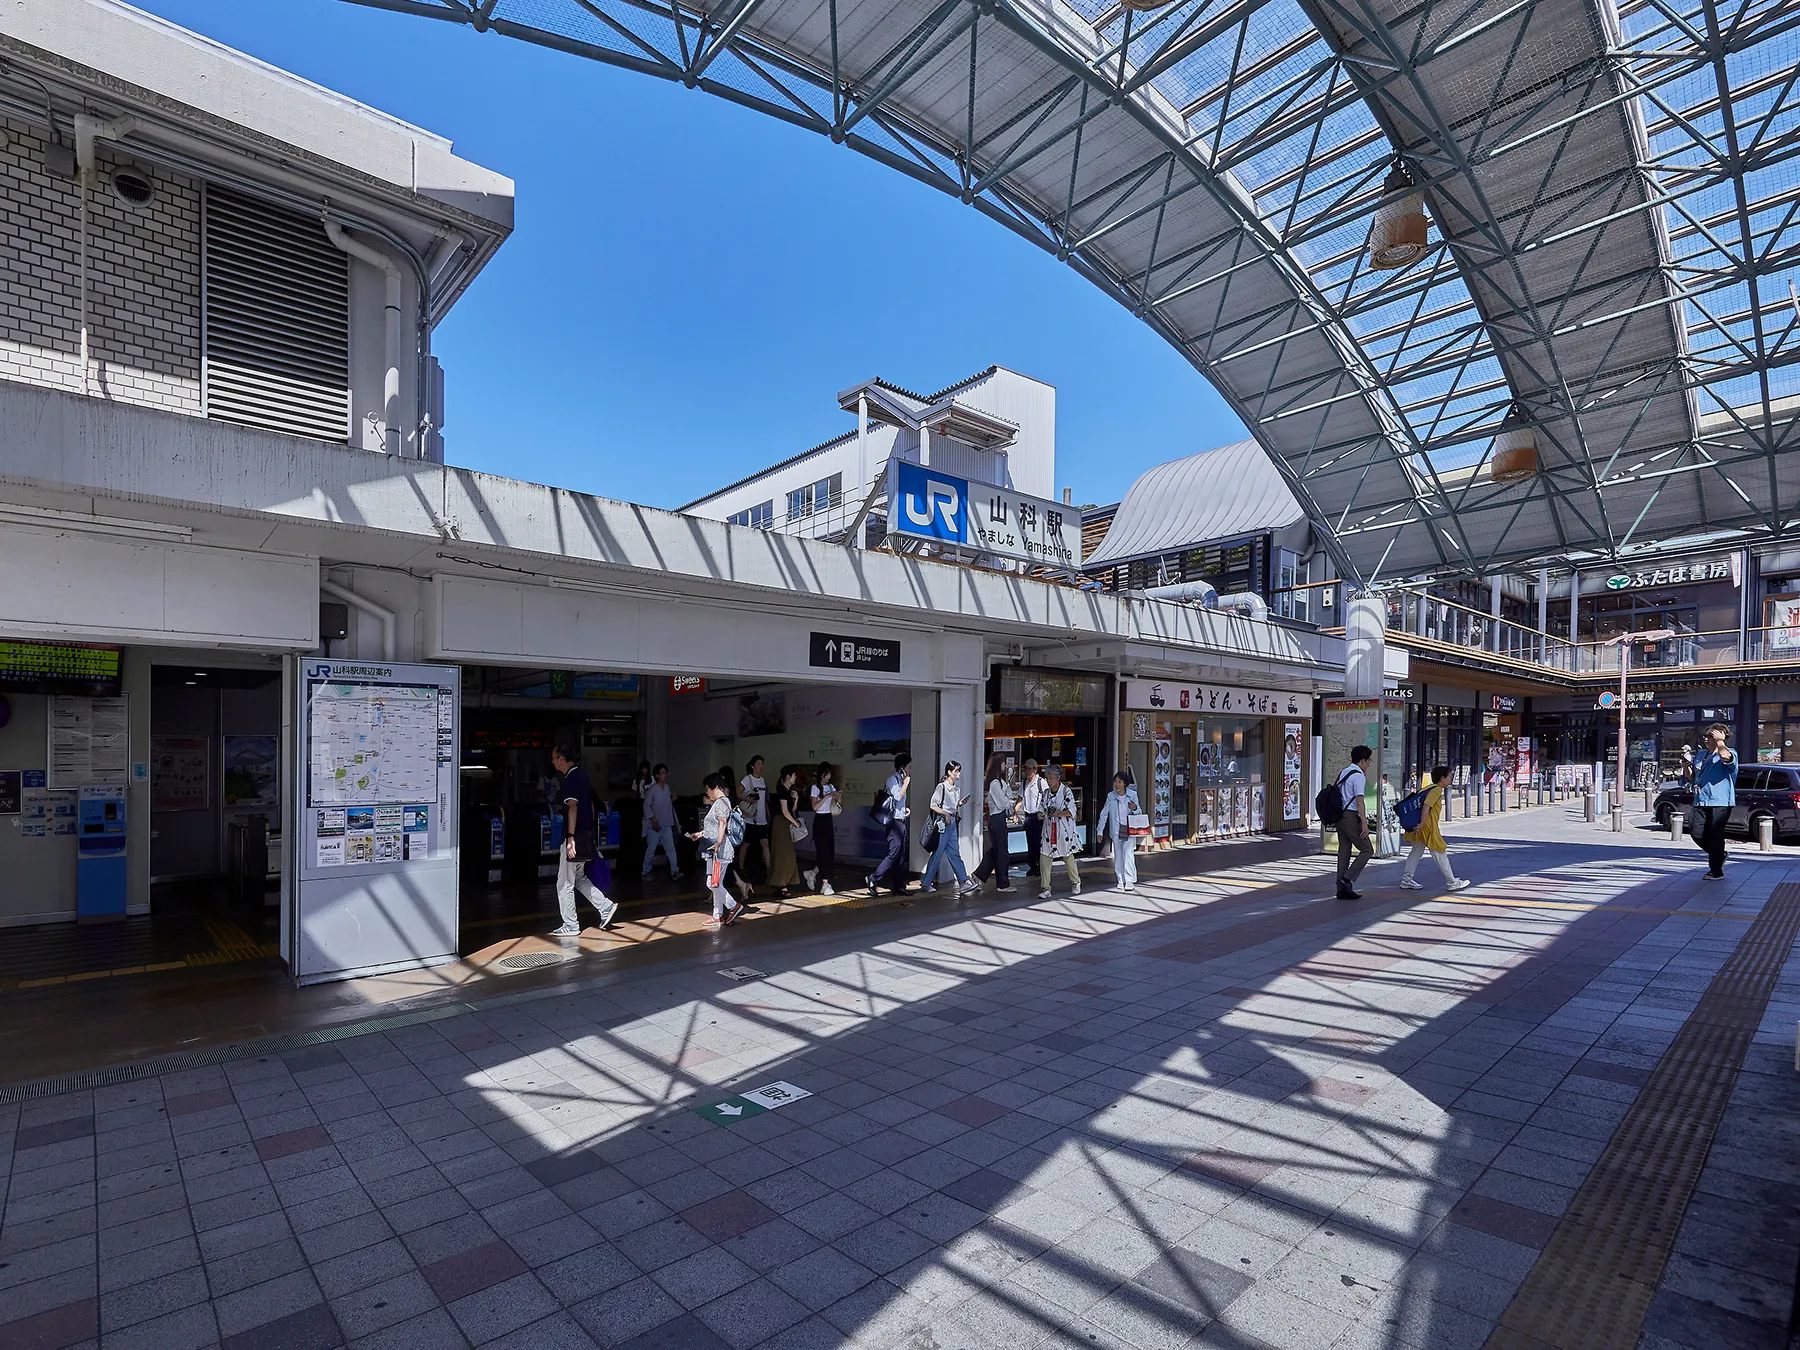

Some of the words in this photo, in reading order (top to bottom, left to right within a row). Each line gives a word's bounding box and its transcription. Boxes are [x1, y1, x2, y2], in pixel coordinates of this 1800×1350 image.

[906, 479, 959, 533] JR
[989, 495, 1063, 538] 山科駅
[977, 527, 1015, 547] やましな
[1021, 536, 1073, 560] Yamashina
[1630, 560, 1729, 587] ふたば書房
[856, 646, 889, 657] JR線のりば
[307, 664, 331, 678] JR
[332, 665, 392, 677] 山科駅周辺案内
[681, 676, 700, 686] Sweets
[1195, 687, 1269, 712] うどん・そば
[1384, 689, 1413, 698] UCKS
